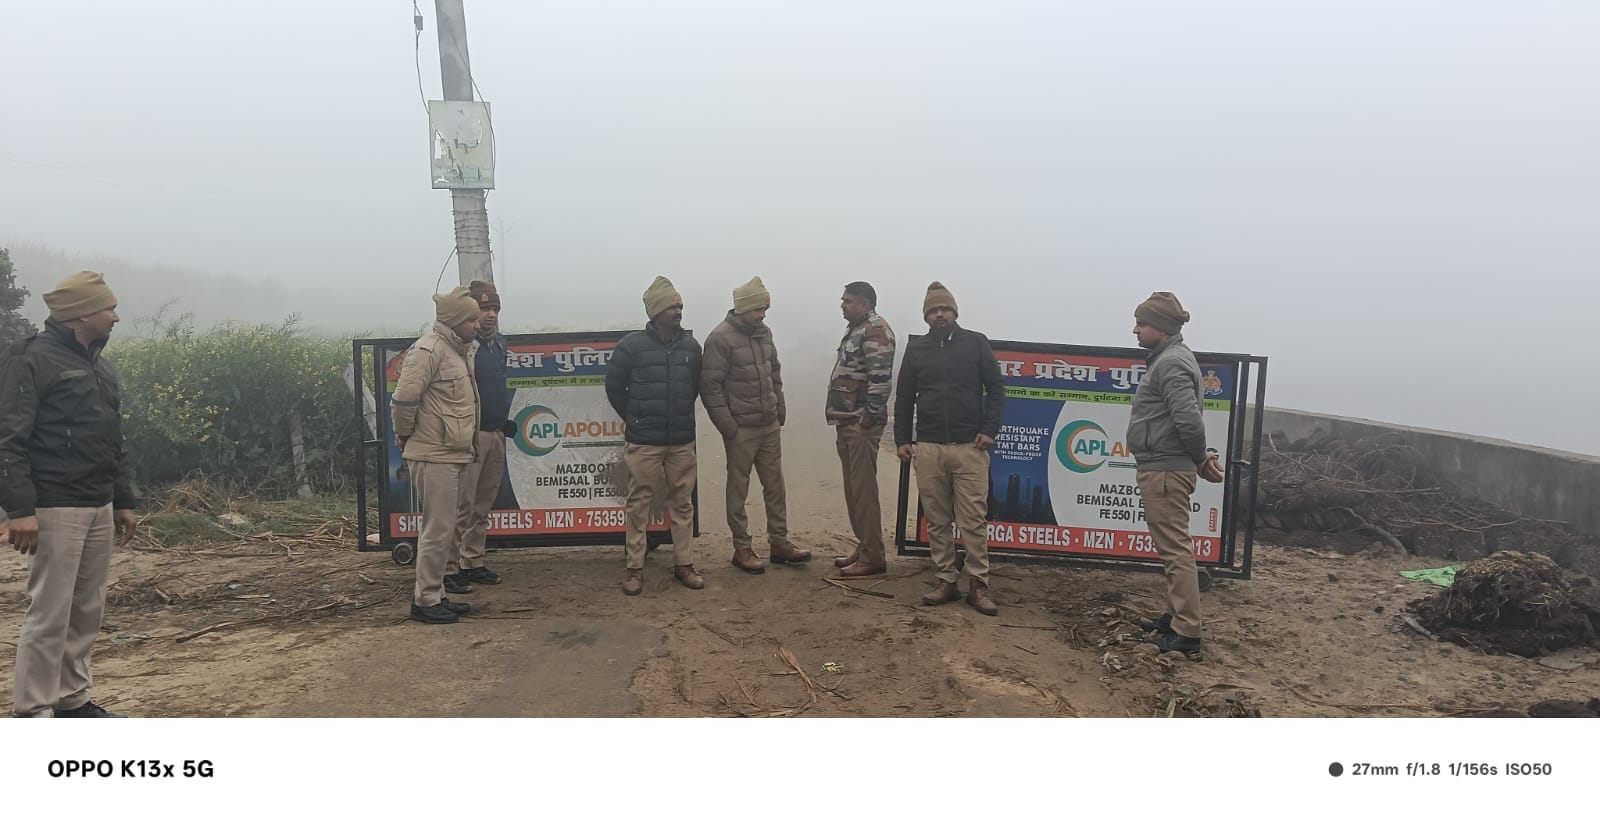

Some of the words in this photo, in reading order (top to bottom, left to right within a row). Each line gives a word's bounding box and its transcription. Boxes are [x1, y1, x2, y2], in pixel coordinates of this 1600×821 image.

[1033, 359, 1100, 382] प्रदेश
[529, 423, 562, 438] APL
[1000, 425, 1049, 435] RTHQUAKE
[997, 441, 1015, 450] TMT
[1017, 443, 1041, 451] BARS
[536, 475, 590, 487] BEMISAAL
[570, 488, 587, 498] 550
[1099, 483, 1141, 496] MAZBO
[1076, 494, 1134, 508] BEMISAAL
[545, 511, 574, 528] MZN
[1111, 510, 1131, 521] 550
[987, 524, 1014, 543] RGA
[1019, 526, 1071, 547] STEELS
[1083, 530, 1115, 550] MZN
